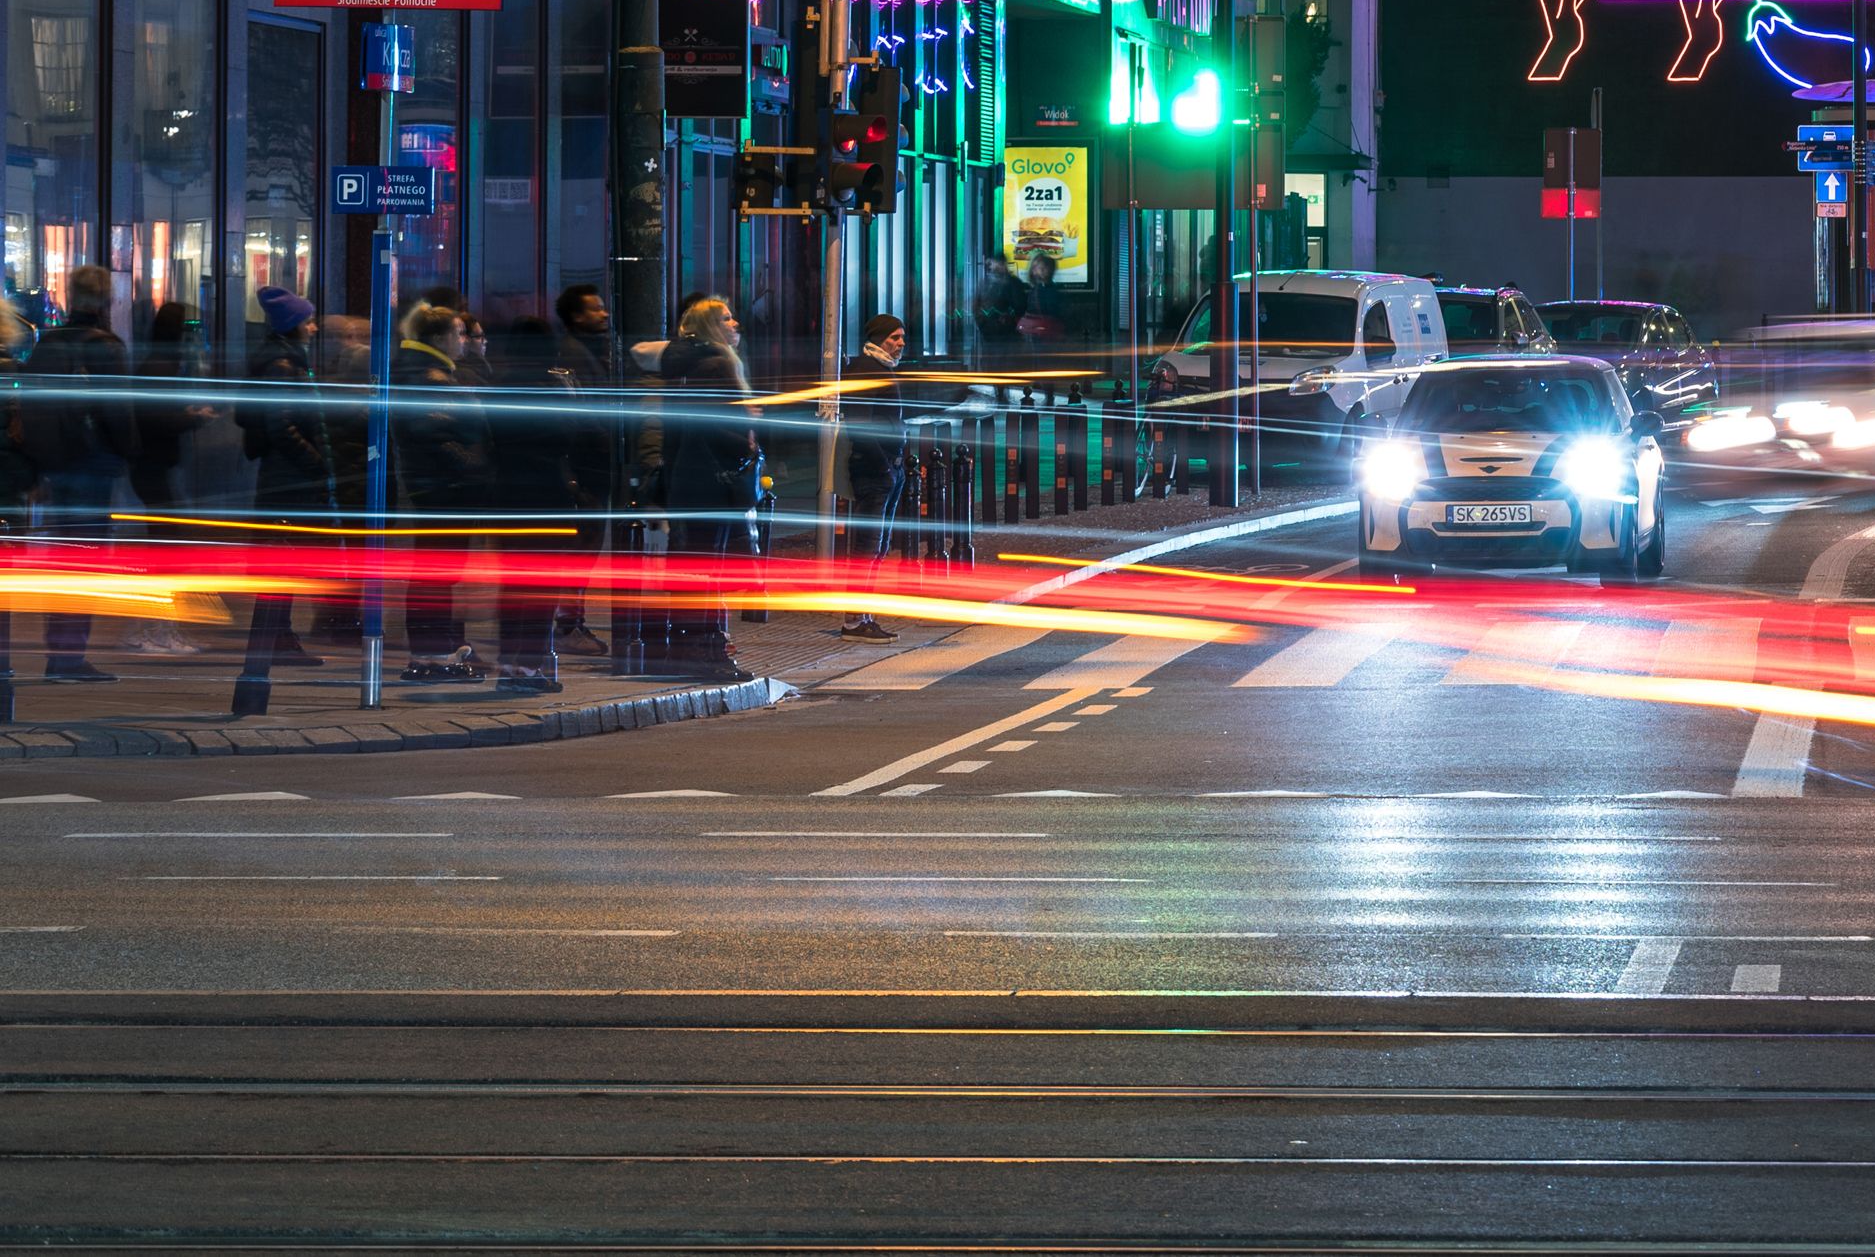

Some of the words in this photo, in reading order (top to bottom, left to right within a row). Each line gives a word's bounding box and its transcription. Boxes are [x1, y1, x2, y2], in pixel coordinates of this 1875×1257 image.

[1044, 109, 1070, 119] Widok
[1011, 158, 1067, 175] Glovo
[387, 174, 416, 183] STREFA
[342, 178, 359, 200] P
[376, 185, 426, 195] PŁATNEGO
[1024, 186, 1063, 201] 2za1
[376, 198, 425, 206] PARKOWANIA
[1456, 507, 1476, 522] SK
[1480, 507, 1528, 522] 265VS
